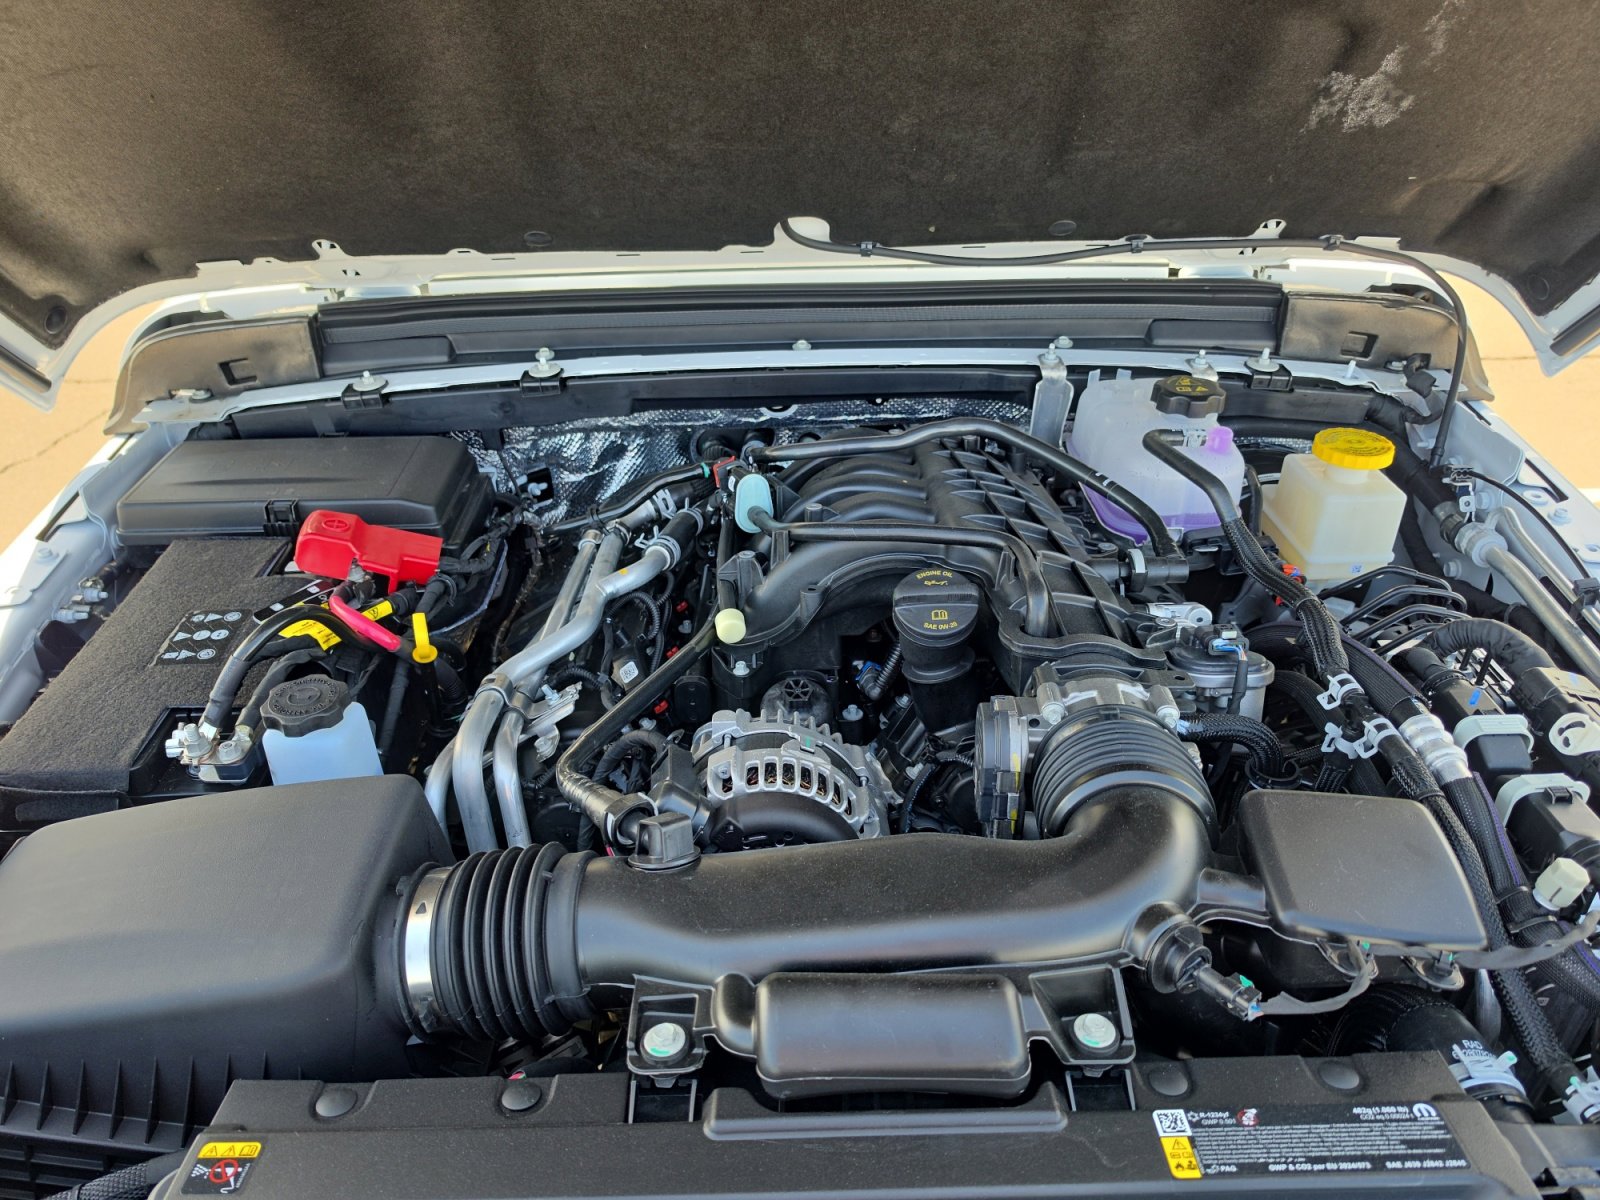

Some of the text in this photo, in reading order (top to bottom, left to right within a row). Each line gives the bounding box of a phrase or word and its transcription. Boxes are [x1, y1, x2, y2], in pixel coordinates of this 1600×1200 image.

[916, 571, 941, 579] ENGINE
[923, 621, 958, 630] SAE 0W-20
[1462, 1039, 1483, 1050] RAD
[1295, 1162, 1313, 1171] CO2
